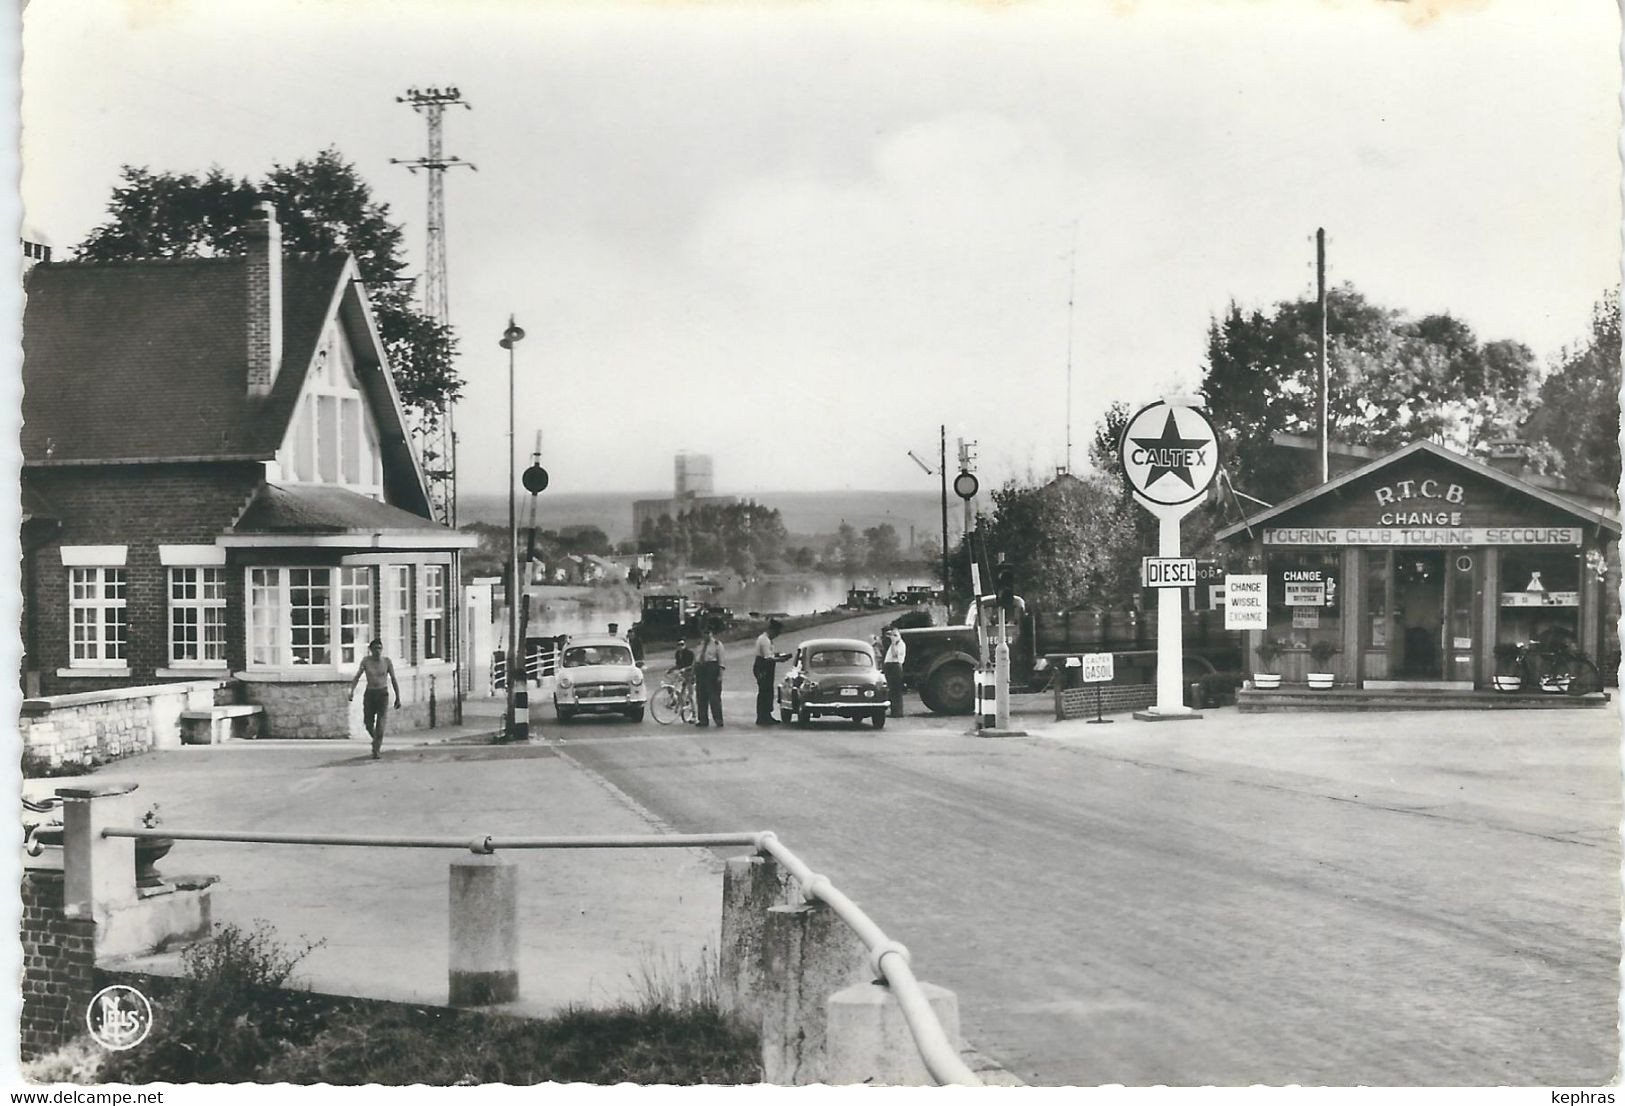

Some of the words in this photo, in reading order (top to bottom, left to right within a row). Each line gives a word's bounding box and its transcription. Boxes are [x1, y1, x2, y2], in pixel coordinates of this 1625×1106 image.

[1131, 448, 1207, 467] CALTEX
[1381, 512, 1462, 526] CHANGE
[1266, 529, 1337, 543] TOURING
[1401, 530, 1473, 544] TOURING
[1283, 571, 1322, 581] CHANGE
[1231, 583, 1261, 591] CHANGE
[1231, 598, 1261, 606] WISSEL
